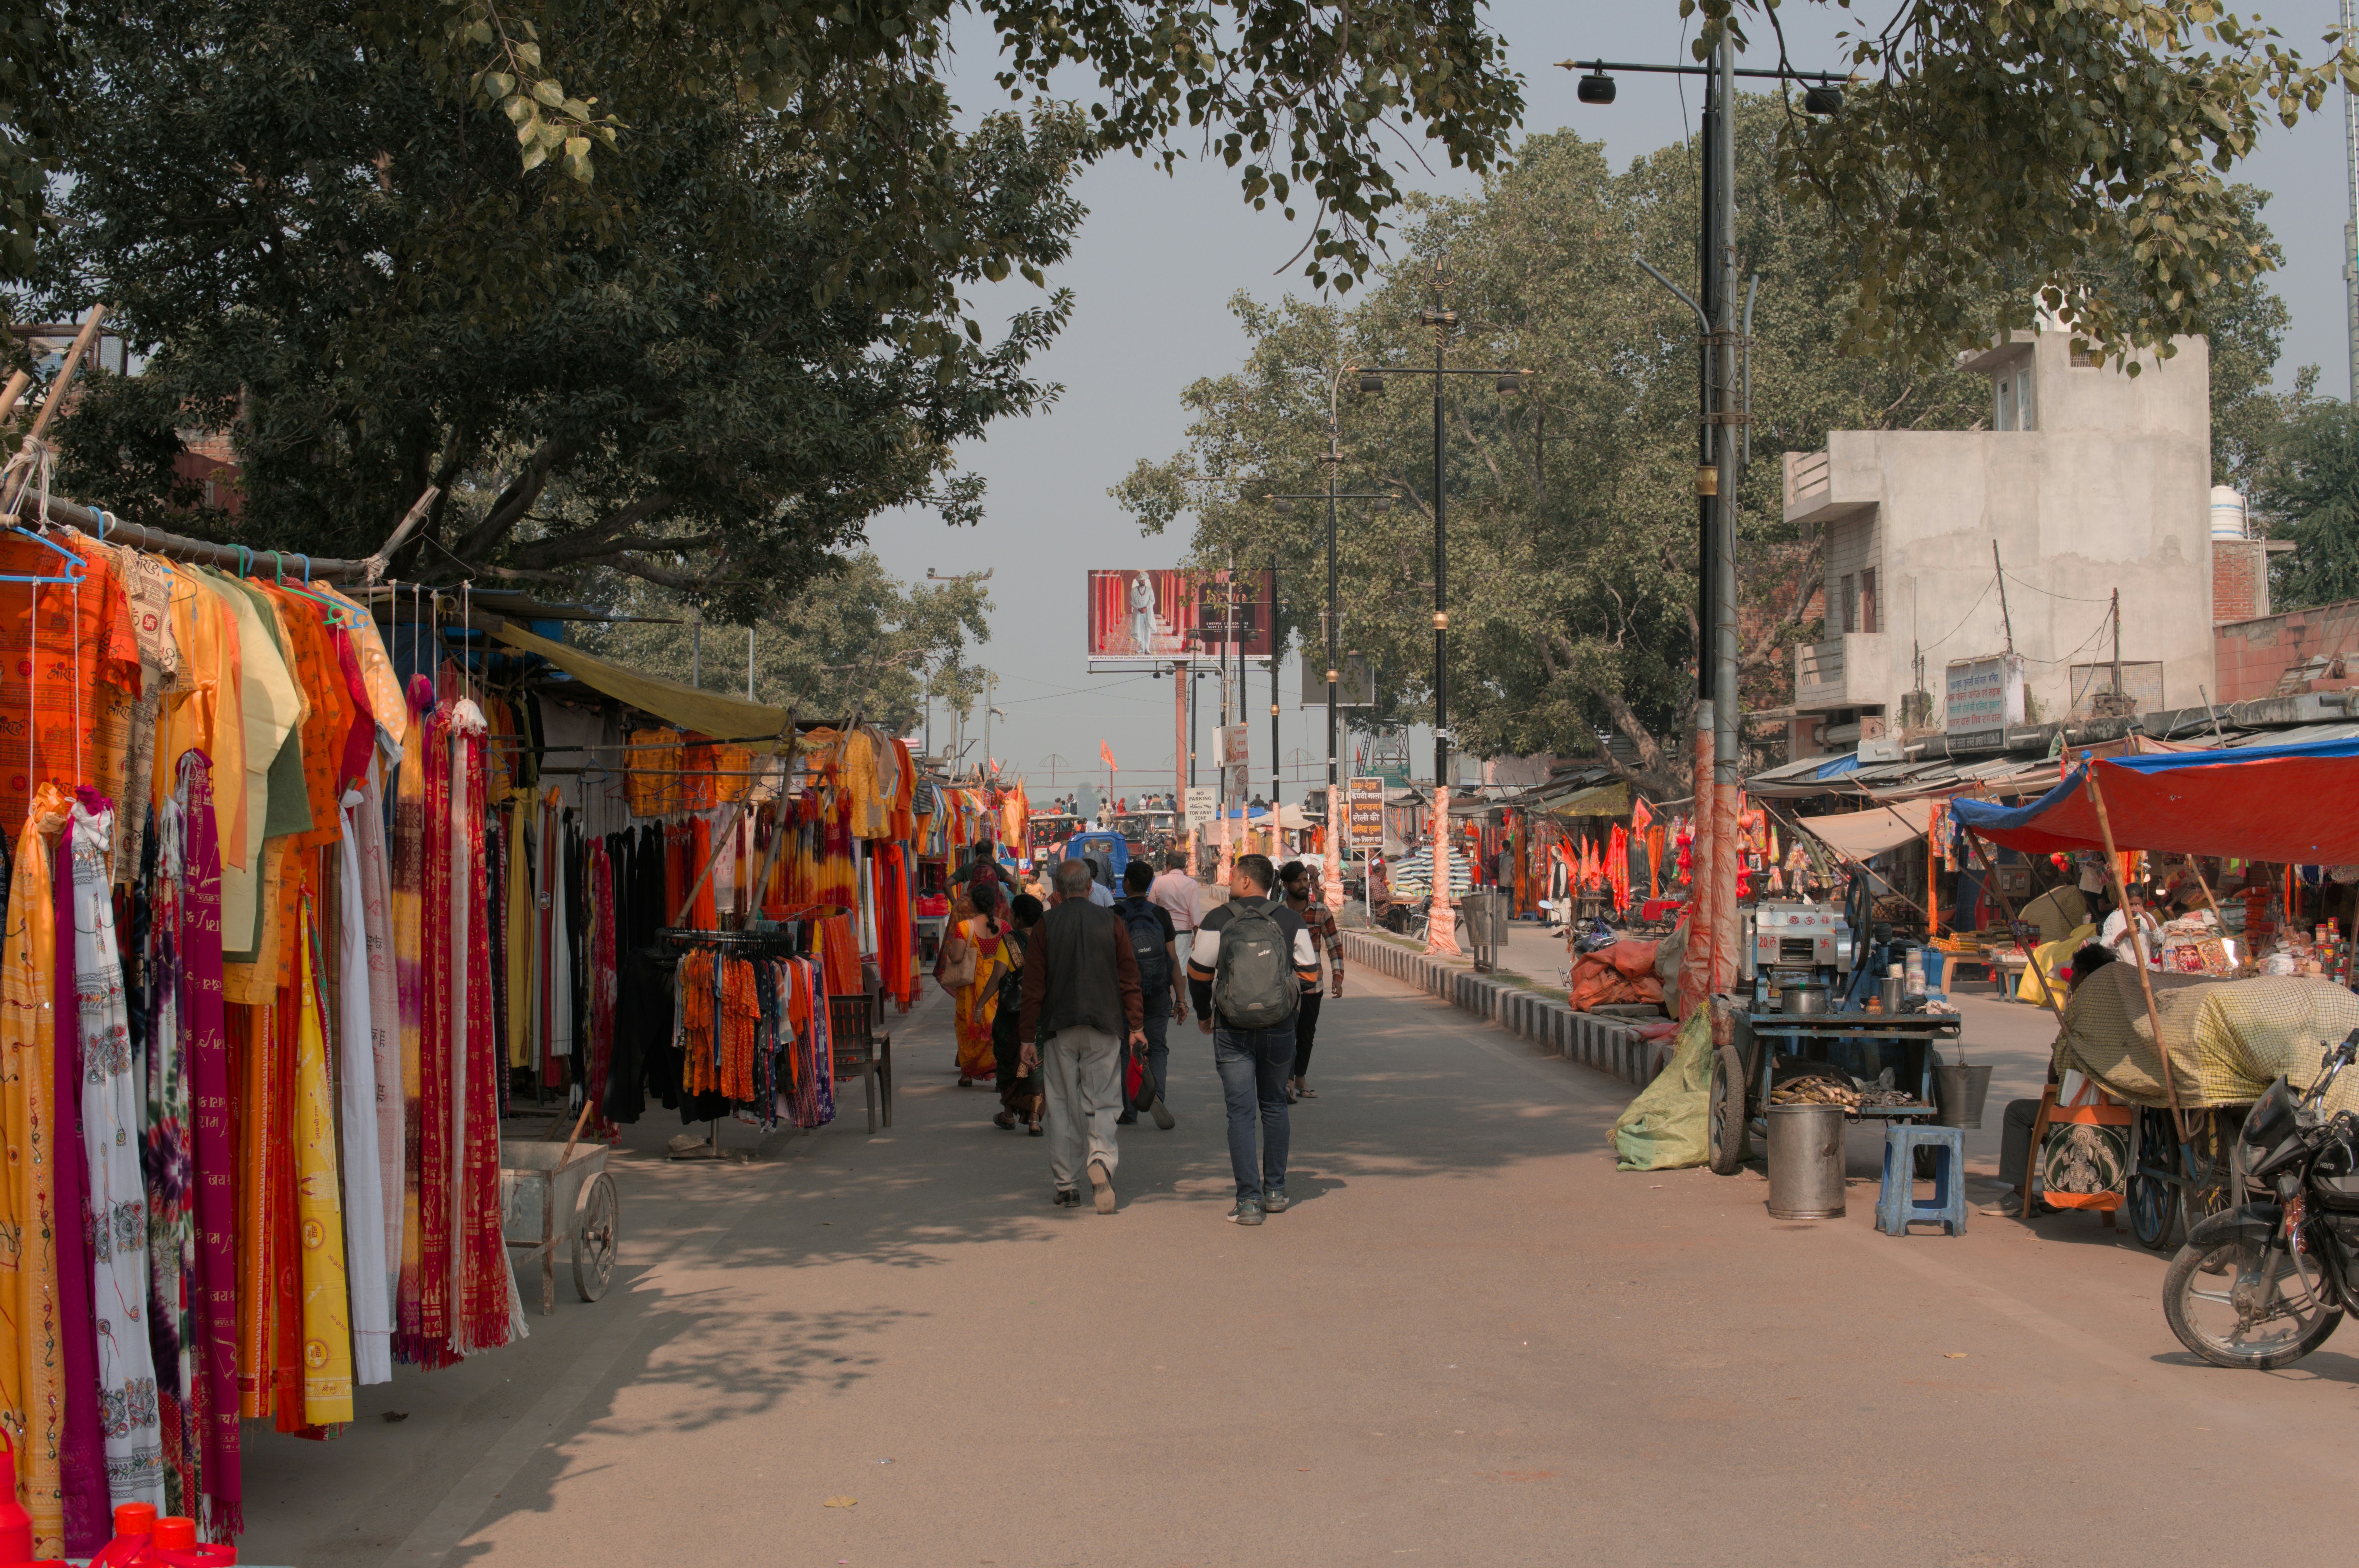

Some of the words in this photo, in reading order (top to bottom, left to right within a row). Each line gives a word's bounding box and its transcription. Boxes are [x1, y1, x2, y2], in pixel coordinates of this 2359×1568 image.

[1989, 673, 1998, 683] मन्दिर
[1961, 717, 1970, 726] दास
[1972, 714, 1981, 725] शिव
[1992, 714, 2001, 723] दास
[1364, 782, 1377, 790] शुद्ध
[1351, 791, 1367, 799] कण्ठी
[1353, 813, 1368, 822] रोली
[1370, 812, 1380, 822] की
[1352, 824, 1368, 833] प्रसिद्ध
[1369, 826, 1382, 834] दुकान
[198, 1116, 219, 1128] राम
[2319, 1162, 2334, 1170] Hero
[209, 1175, 226, 1186] जय
[210, 1291, 228, 1302] जय
